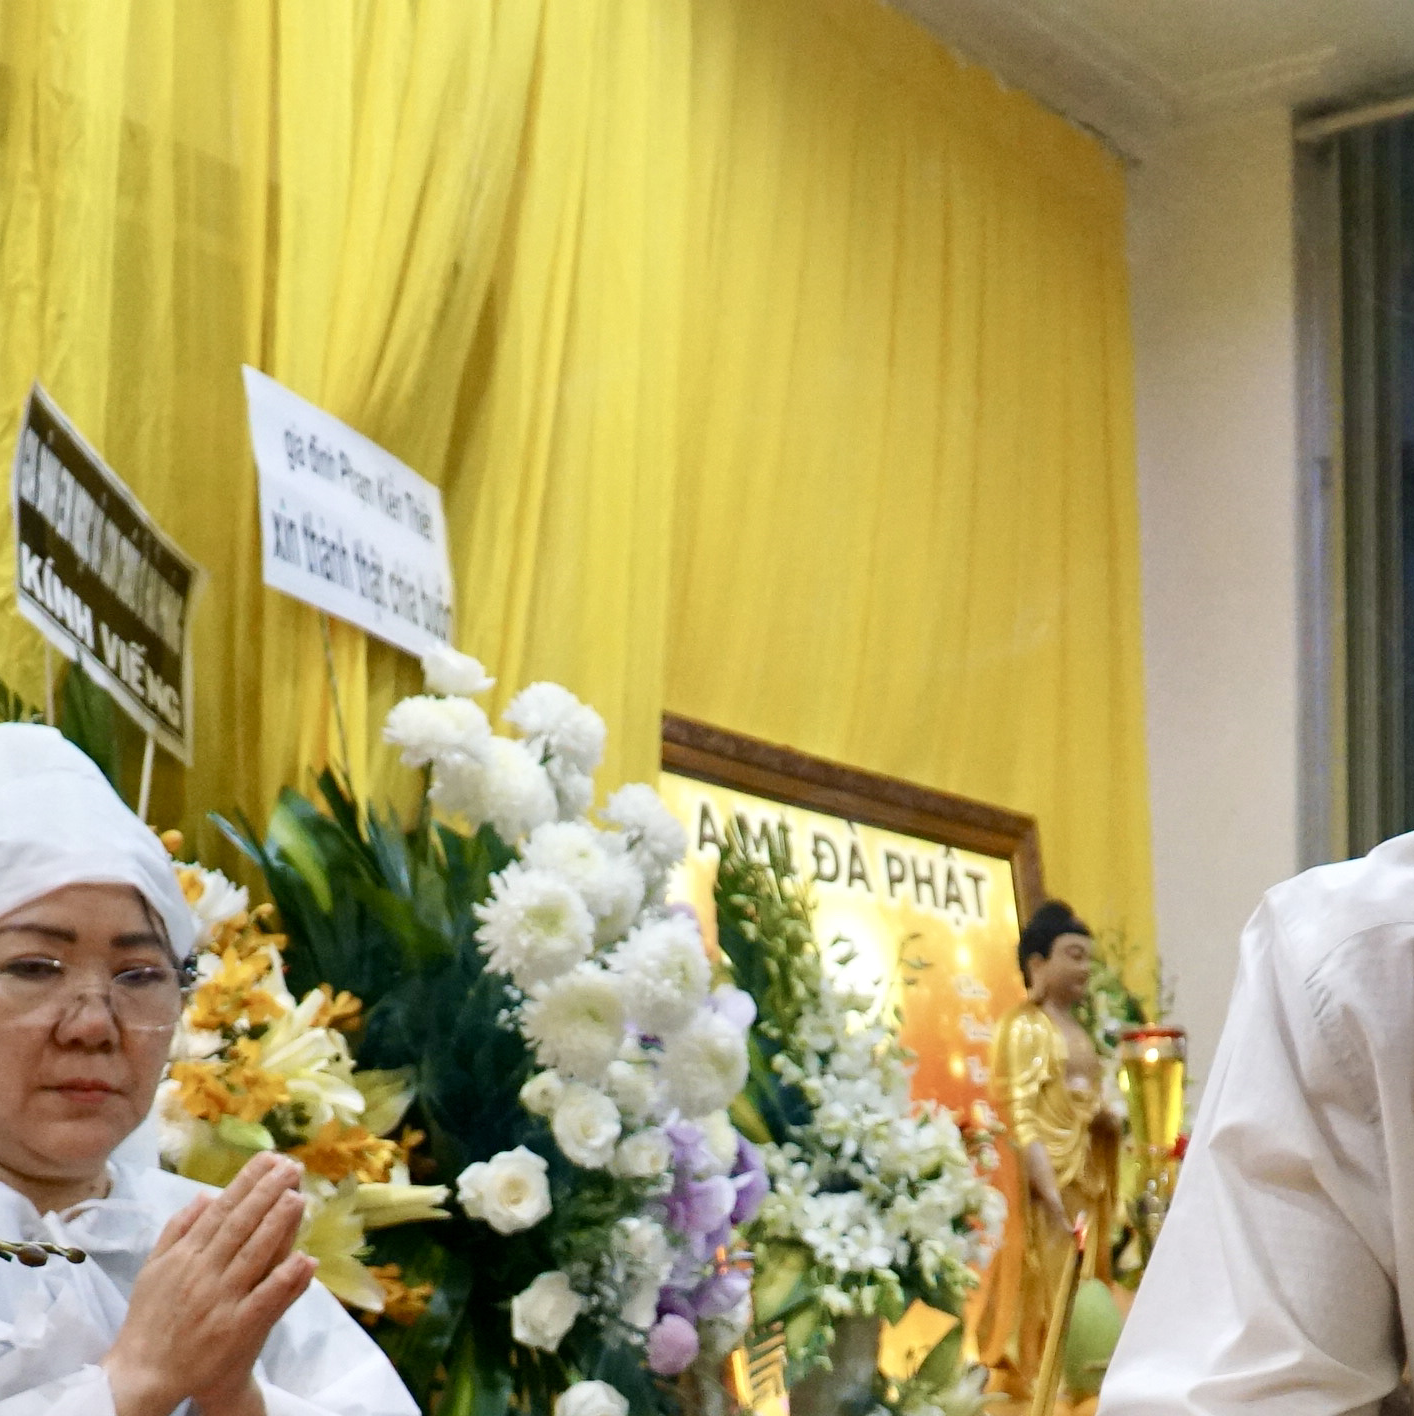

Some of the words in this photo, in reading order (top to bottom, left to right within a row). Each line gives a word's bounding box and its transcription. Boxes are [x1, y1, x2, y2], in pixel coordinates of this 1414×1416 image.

[20, 542, 95, 650] KÍNH
[98, 620, 182, 730] VIẾNG
[811, 819, 874, 893] ĐÀ
[885, 844, 988, 927] PHẬT
